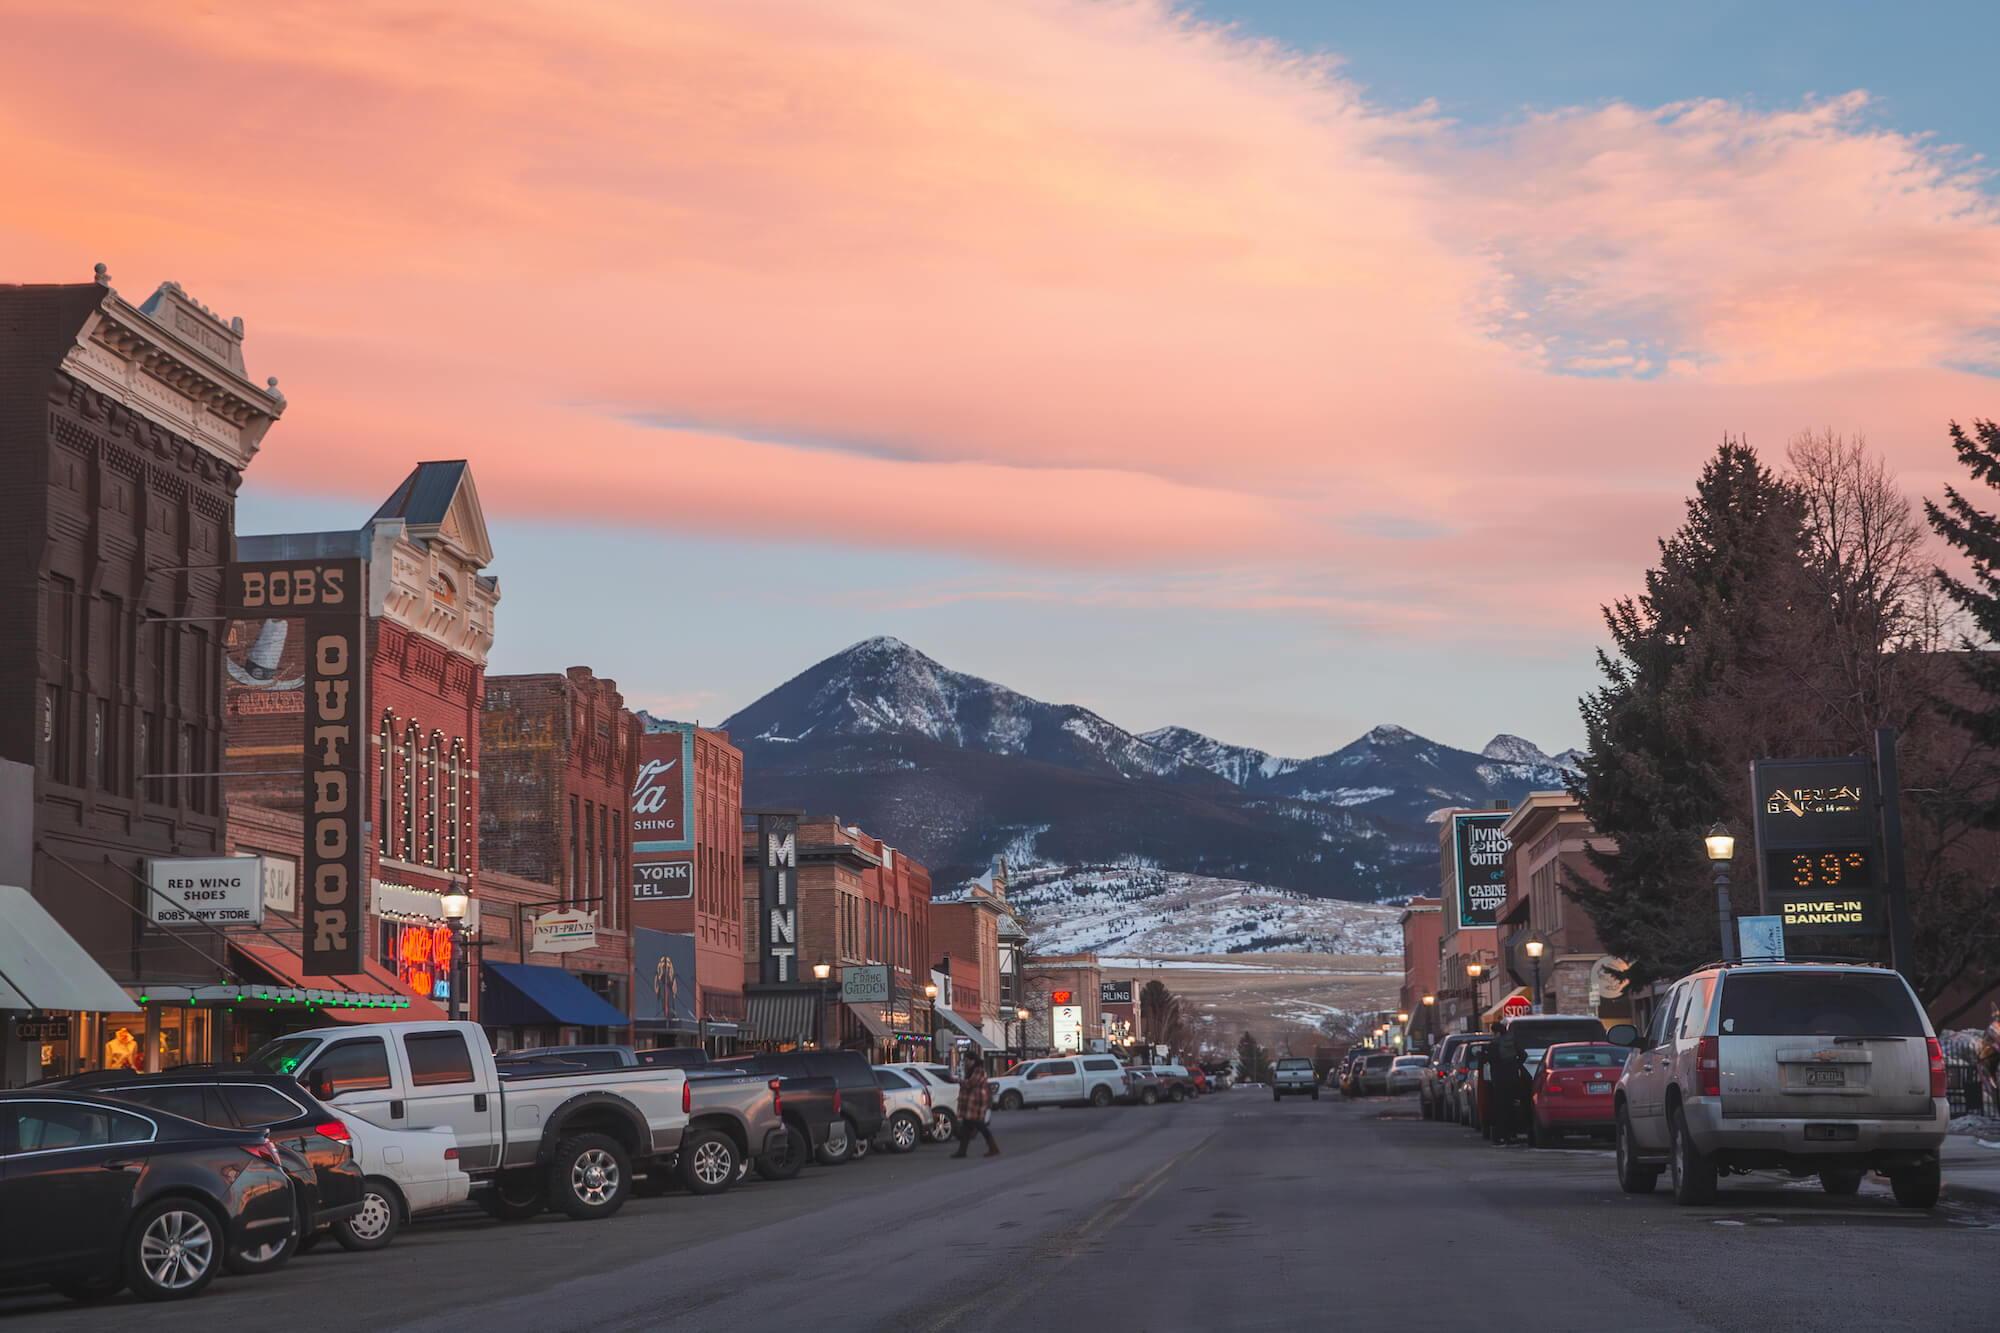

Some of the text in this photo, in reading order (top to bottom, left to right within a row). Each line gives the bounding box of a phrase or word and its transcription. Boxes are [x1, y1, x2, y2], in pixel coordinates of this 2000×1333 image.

[242, 568, 344, 607] BOB'S
[313, 635, 349, 951] OUTDOOR
[634, 819, 676, 830] SHING
[640, 865, 688, 880] YORK
[168, 878, 241, 889] RED WING
[184, 890, 226, 901] SHOES
[634, 884, 663, 896] TEL
[768, 833, 796, 982] MINT
[1784, 902, 1862, 913] DRIVE-IN
[158, 910, 185, 921] BOB'S
[219, 910, 250, 920] STORE
[1785, 913, 1863, 924] BANKING
[534, 922, 594, 935] INSTY-PRINTS
[845, 981, 887, 995] GARDEN
[1103, 991, 1130, 1001] RLING
[1505, 1006, 1530, 1017] STOP
